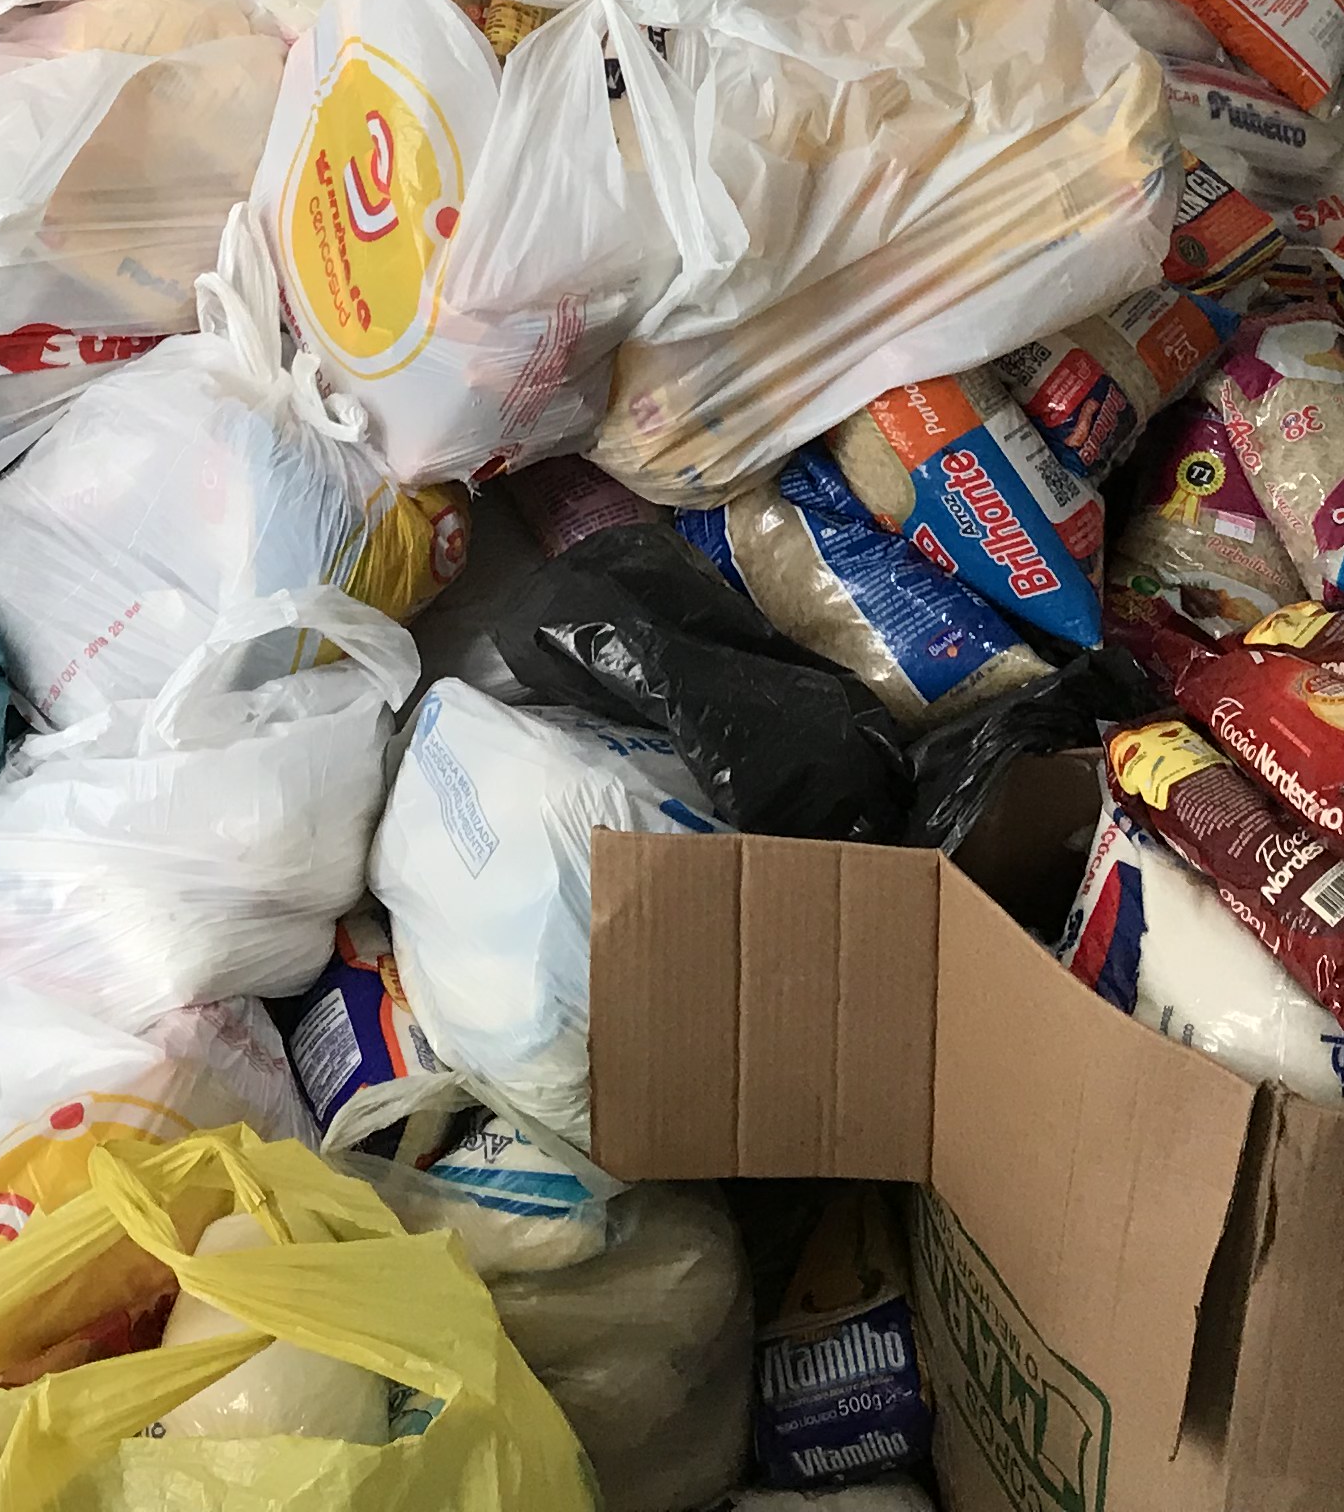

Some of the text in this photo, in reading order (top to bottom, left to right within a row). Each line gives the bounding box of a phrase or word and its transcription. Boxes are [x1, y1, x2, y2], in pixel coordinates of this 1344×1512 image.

[1206, 90, 1307, 150] Pinheiro
[307, 195, 353, 329] cencosud
[1280, 405, 1323, 443] 38
[1190, 463, 1212, 483] T1
[941, 448, 1061, 599] Brilhante
[943, 493, 981, 539] Arroz
[1209, 696, 1257, 760] Flocão
[1253, 740, 1344, 834] Nordestino
[1255, 820, 1312, 866] Floc
[1260, 840, 1326, 907] Nordes
[761, 1319, 908, 1397] Vitamilho
[836, 1391, 883, 1418] 500g
[790, 1427, 909, 1479] Vitamilho
